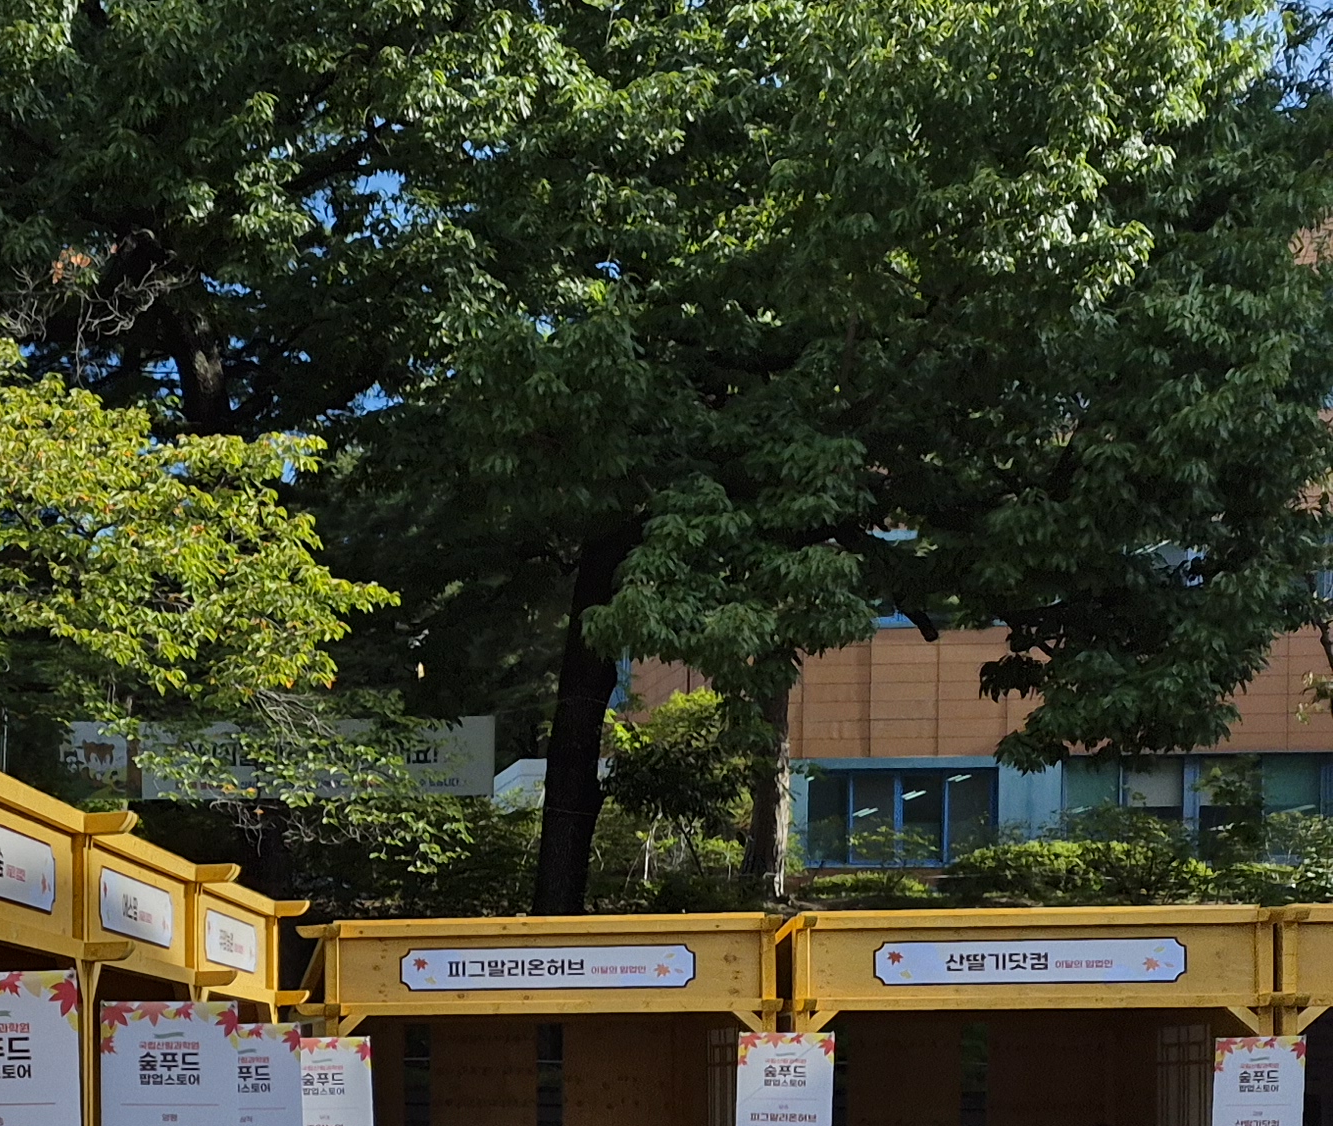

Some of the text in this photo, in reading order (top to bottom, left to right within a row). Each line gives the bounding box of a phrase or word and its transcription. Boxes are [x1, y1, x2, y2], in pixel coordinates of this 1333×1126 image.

[447, 959, 585, 978] 피그말리온허브
[945, 953, 1049, 972] 산딸기닷컴
[138, 1051, 200, 1072] 숲푸드
[764, 1065, 807, 1078] 숲푸드
[1239, 1070, 1279, 1083] 숲푸드
[139, 1073, 200, 1086] 팝업스토어
[301, 1072, 345, 1086] 숲푸드
